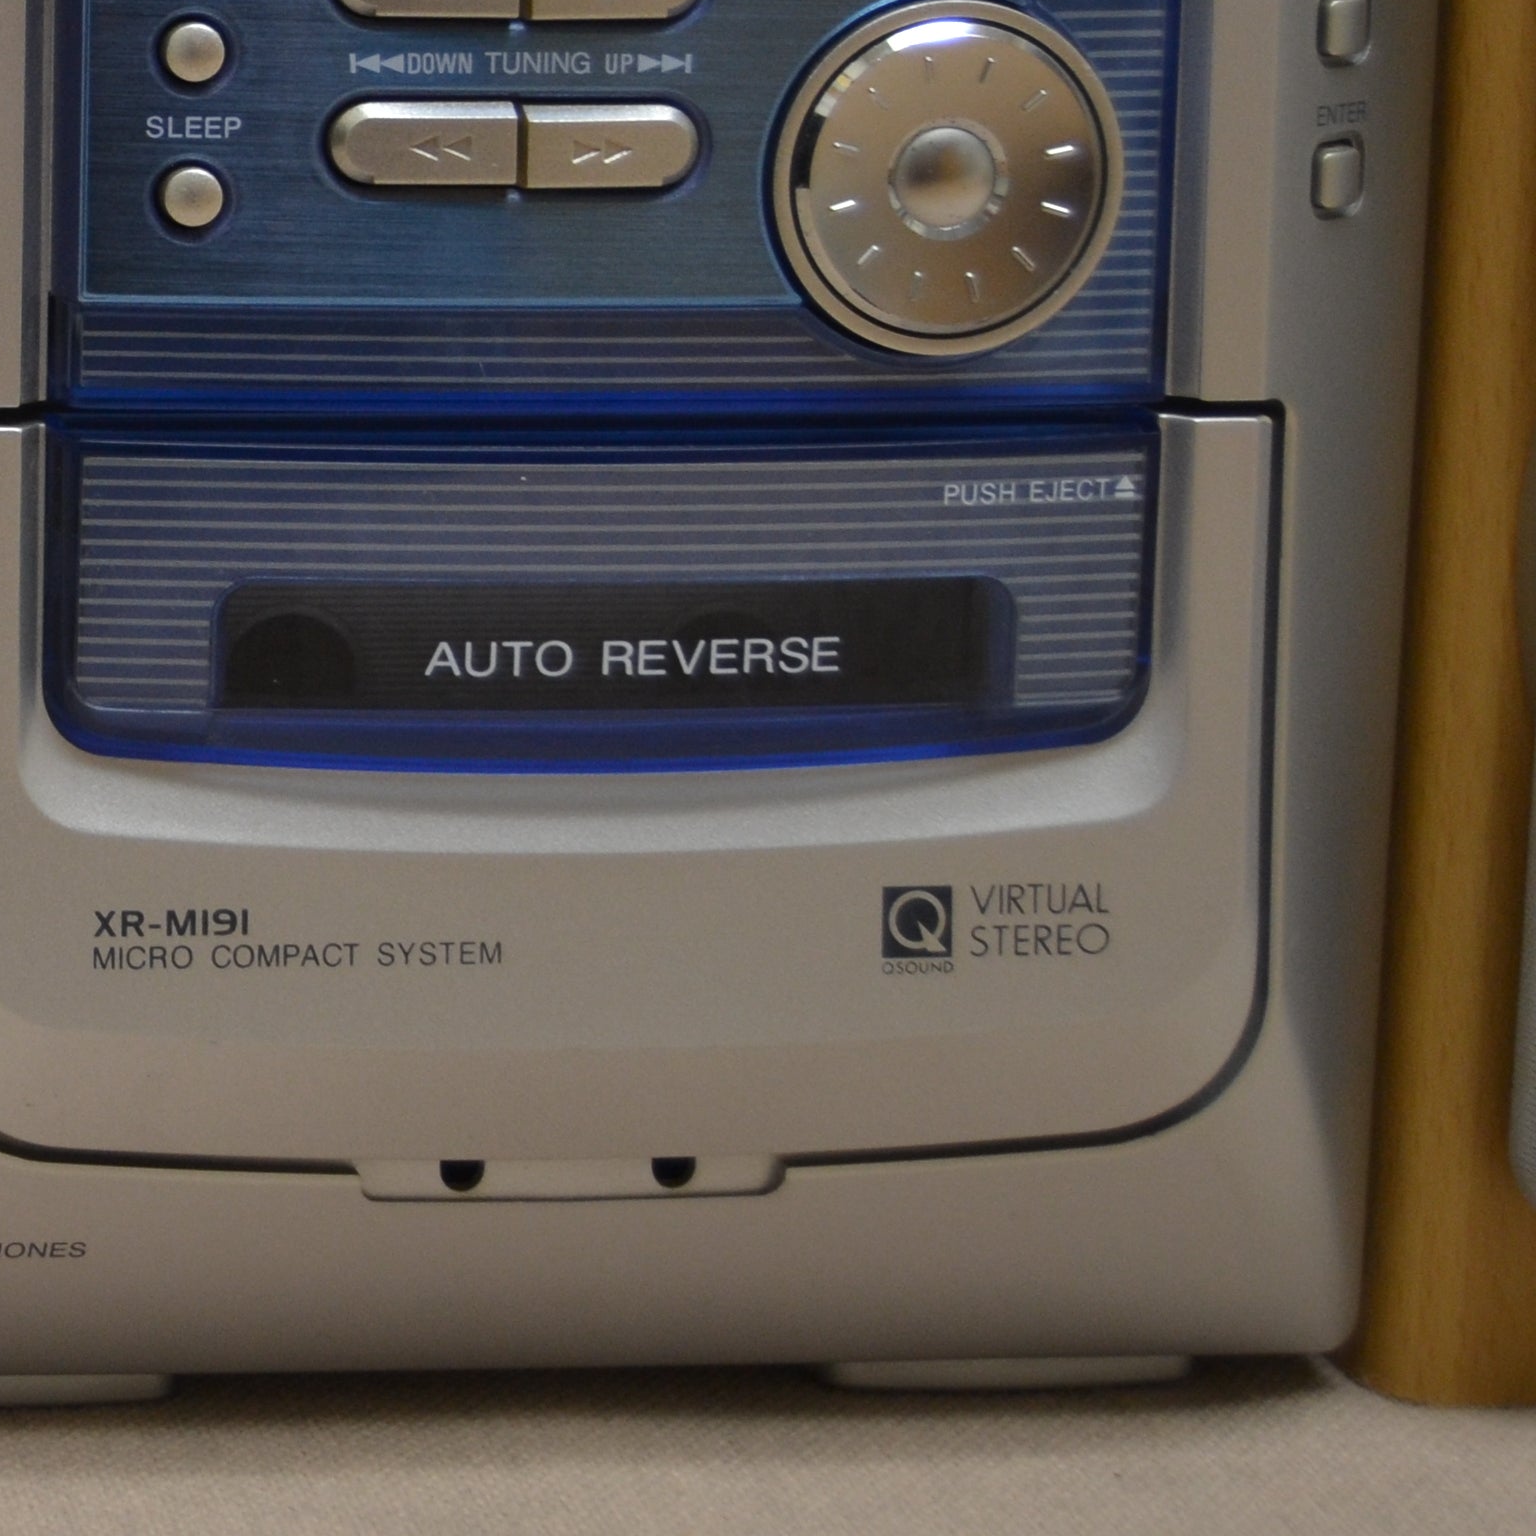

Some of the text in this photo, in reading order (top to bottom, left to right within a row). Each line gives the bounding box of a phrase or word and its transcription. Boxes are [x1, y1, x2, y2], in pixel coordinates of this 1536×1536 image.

[406, 51, 634, 75] DOWN TUNING UP
[144, 115, 243, 139] SLEEP
[1316, 100, 1368, 127] ENTER
[943, 477, 1111, 506] PUSH EJECT
[424, 636, 841, 678] AUTO REVERSE
[970, 883, 1111, 915] VIRTUAL
[970, 923, 1111, 956] STEREO
[92, 940, 504, 970] MICRO COMPACT SYSTEM
[882, 960, 955, 976] QSOUND
